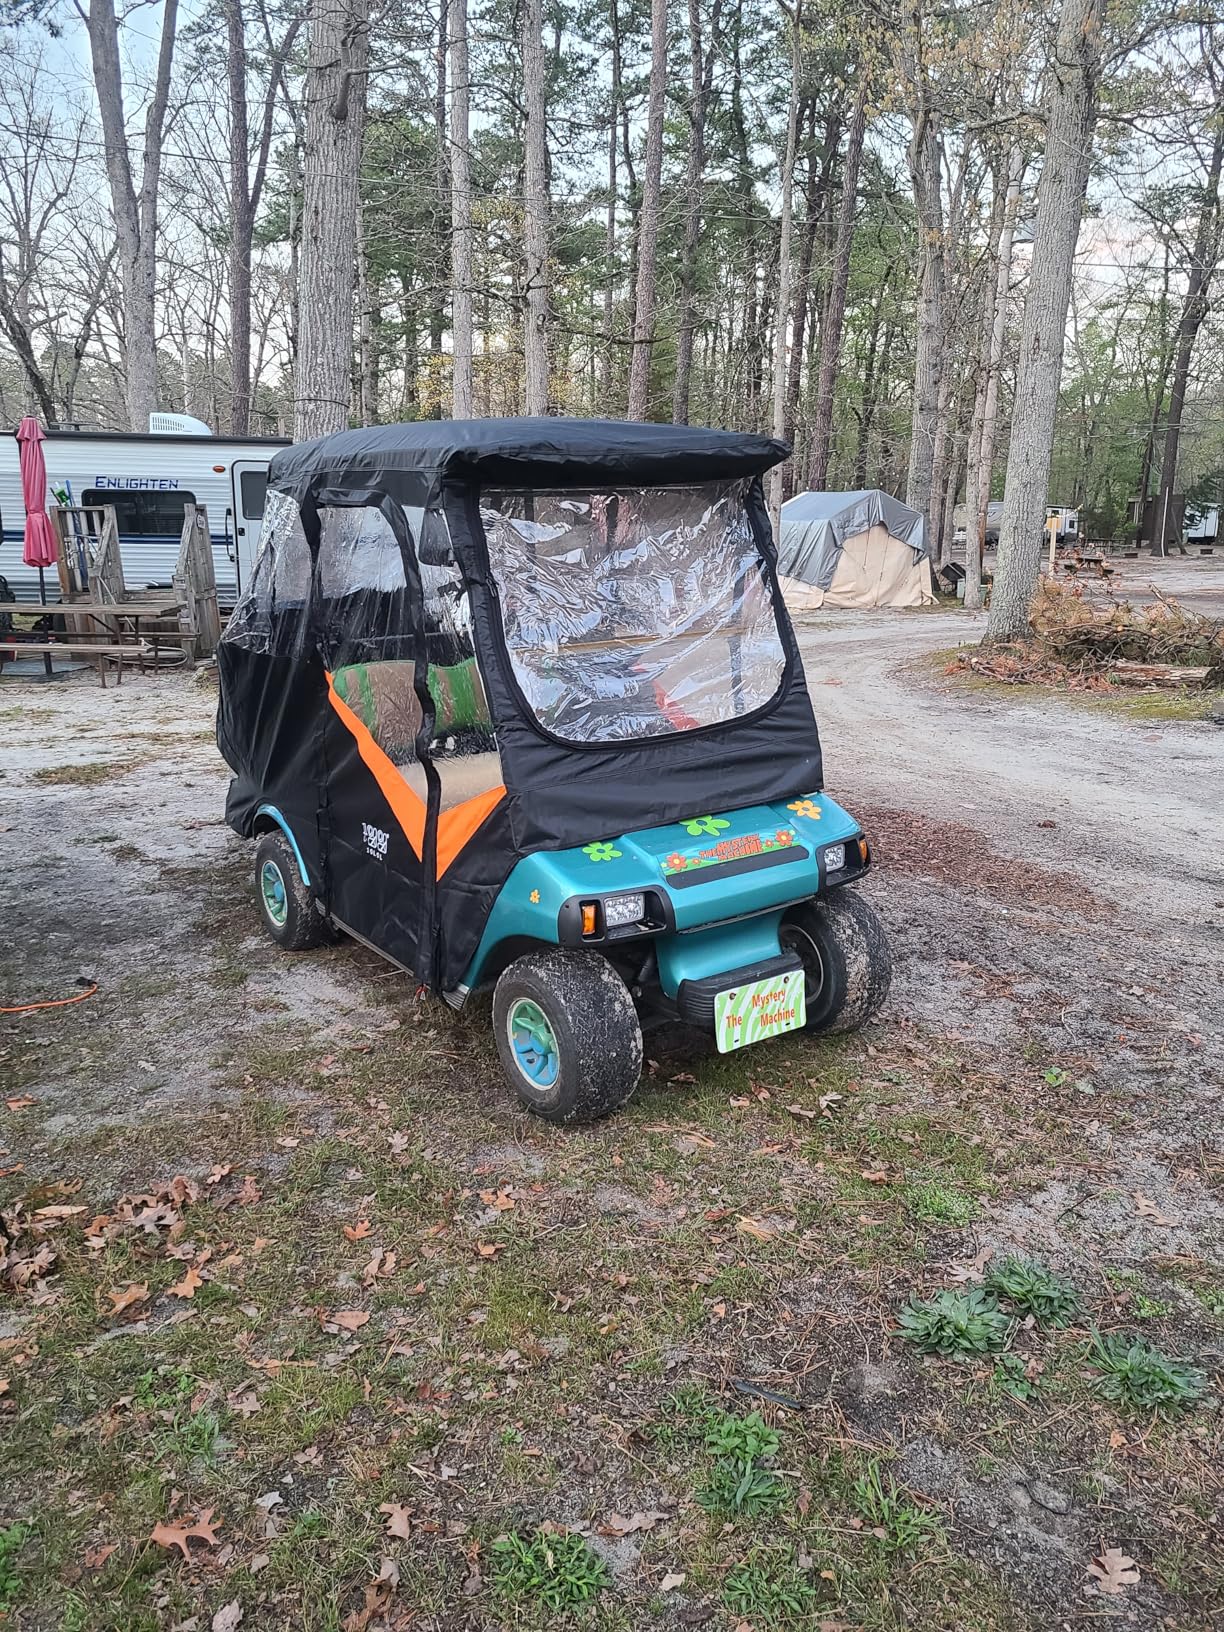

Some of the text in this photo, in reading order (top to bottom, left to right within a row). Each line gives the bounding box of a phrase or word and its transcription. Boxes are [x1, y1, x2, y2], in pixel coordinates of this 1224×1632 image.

[700, 849, 717, 858] THE
[718, 840, 762, 860] MACHINE
[752, 989, 786, 1008] Mystery
[726, 1008, 795, 1028] The Machine
